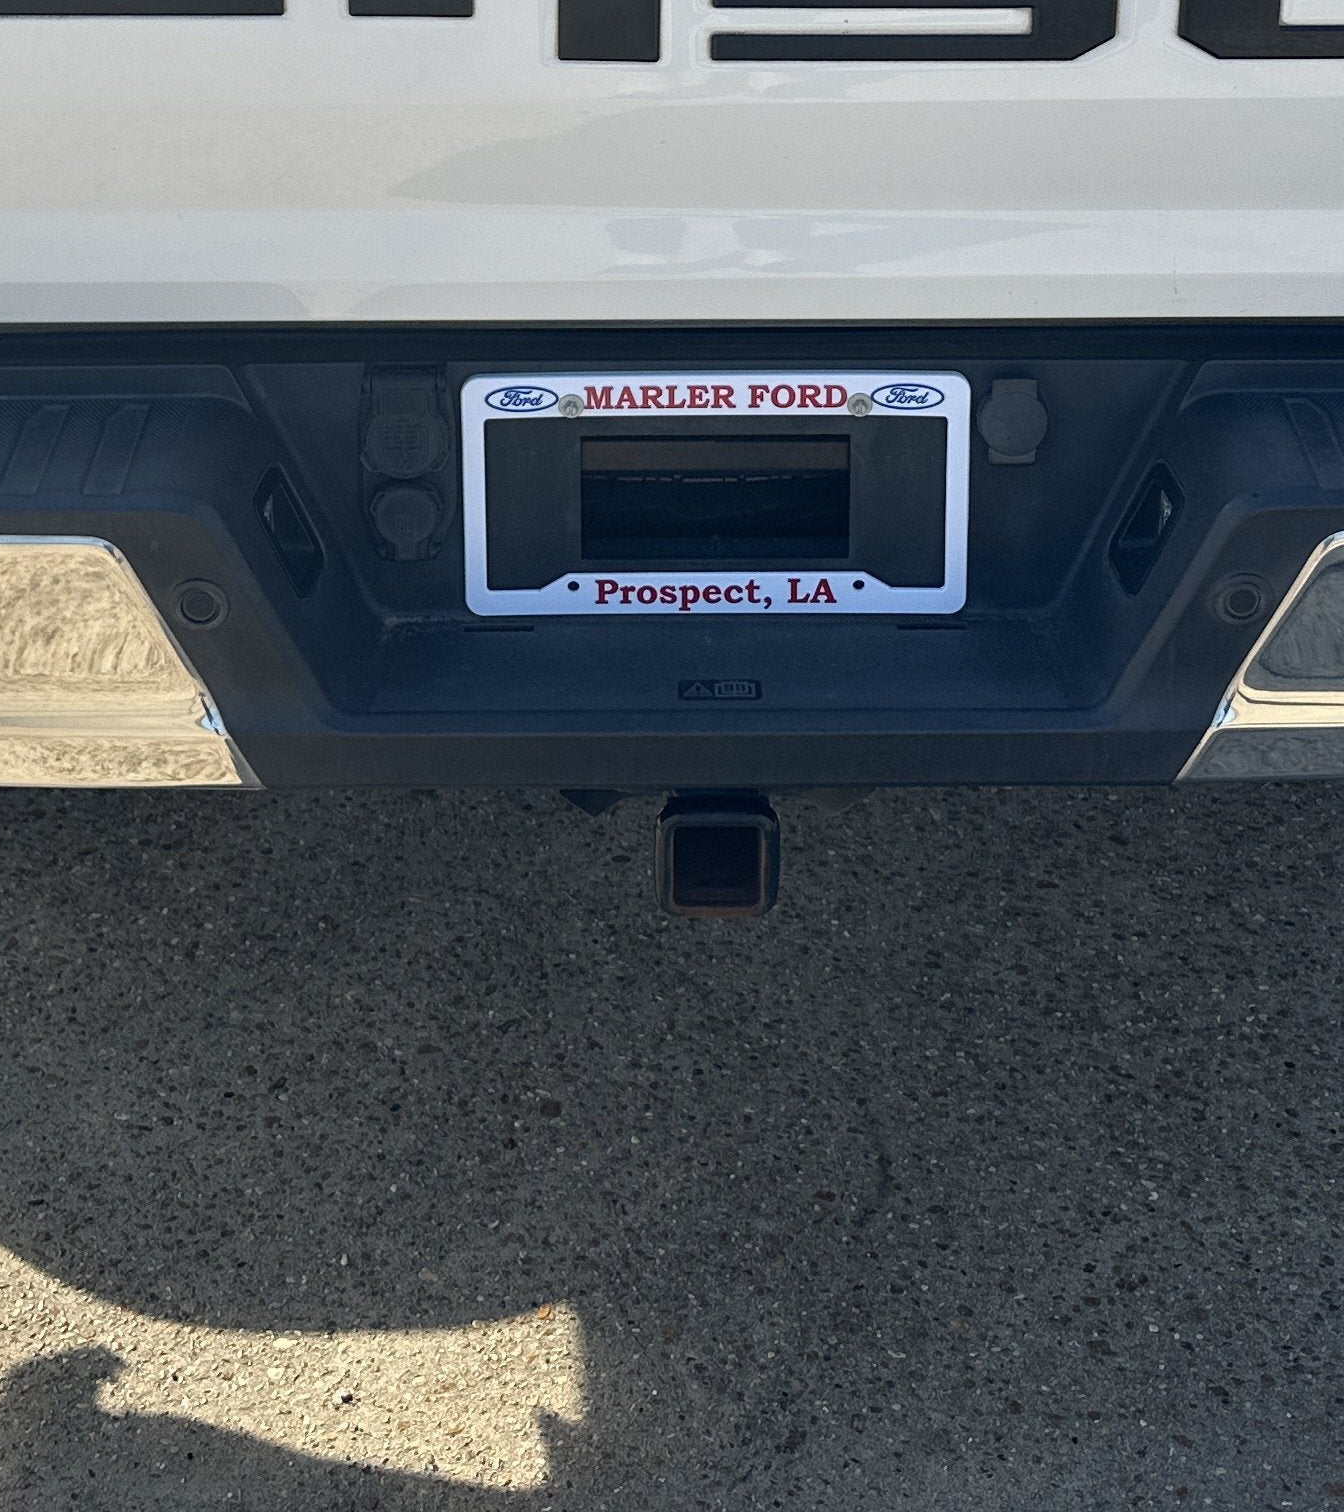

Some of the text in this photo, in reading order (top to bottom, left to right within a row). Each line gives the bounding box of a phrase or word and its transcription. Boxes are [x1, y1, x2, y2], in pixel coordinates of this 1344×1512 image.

[499, 390, 544, 407] Ford
[583, 384, 848, 410] MARLER FORD
[884, 387, 929, 405] Ford
[595, 579, 837, 612] Prospect, LA
